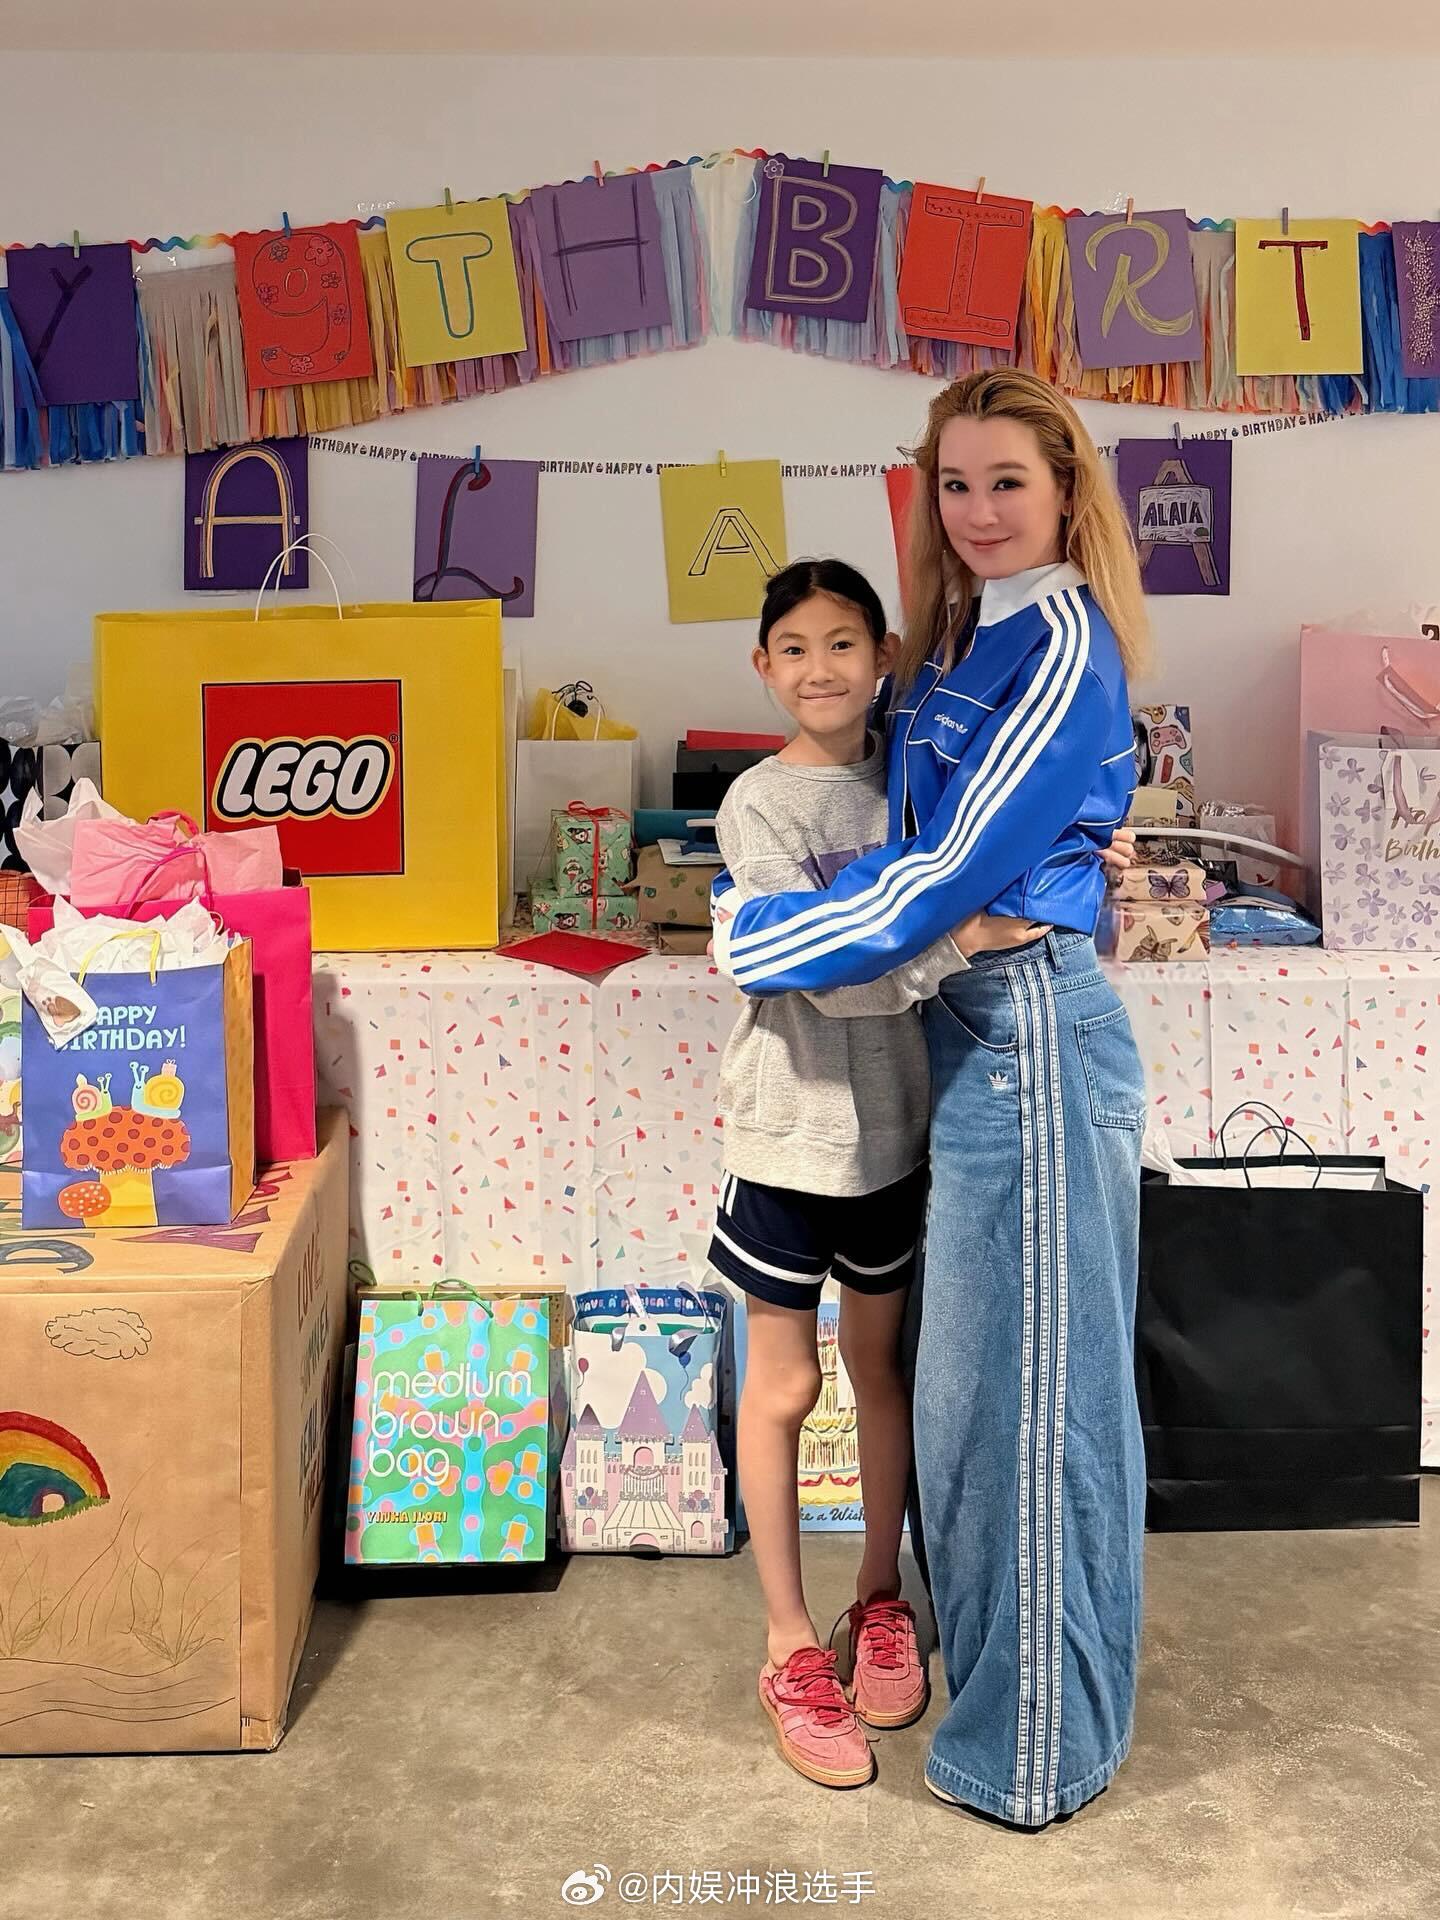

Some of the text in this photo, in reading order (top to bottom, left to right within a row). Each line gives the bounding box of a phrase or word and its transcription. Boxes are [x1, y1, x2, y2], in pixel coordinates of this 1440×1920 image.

[309, 436, 358, 455] IRTHDAY
[369, 445, 407, 462] HAPPY
[539, 460, 594, 474] BIRTHDAY
[605, 462, 642, 475] HAPPY
[781, 464, 829, 478] IRTHDAY
[840, 463, 877, 477] HAPPY
[1241, 415, 1297, 437] BIRTHDAY
[1142, 500, 1204, 527] ALAIA
[217, 740, 390, 817] LEGO
[1384, 837, 1440, 863] Birth
[96, 1004, 157, 1026] APPY
[62, 1024, 187, 1051] IRTHDAY!
[373, 1363, 532, 1399] medium
[371, 1402, 500, 1439] brown
[369, 1440, 450, 1486] bag
[367, 1510, 448, 1523] YINKA ILORI
